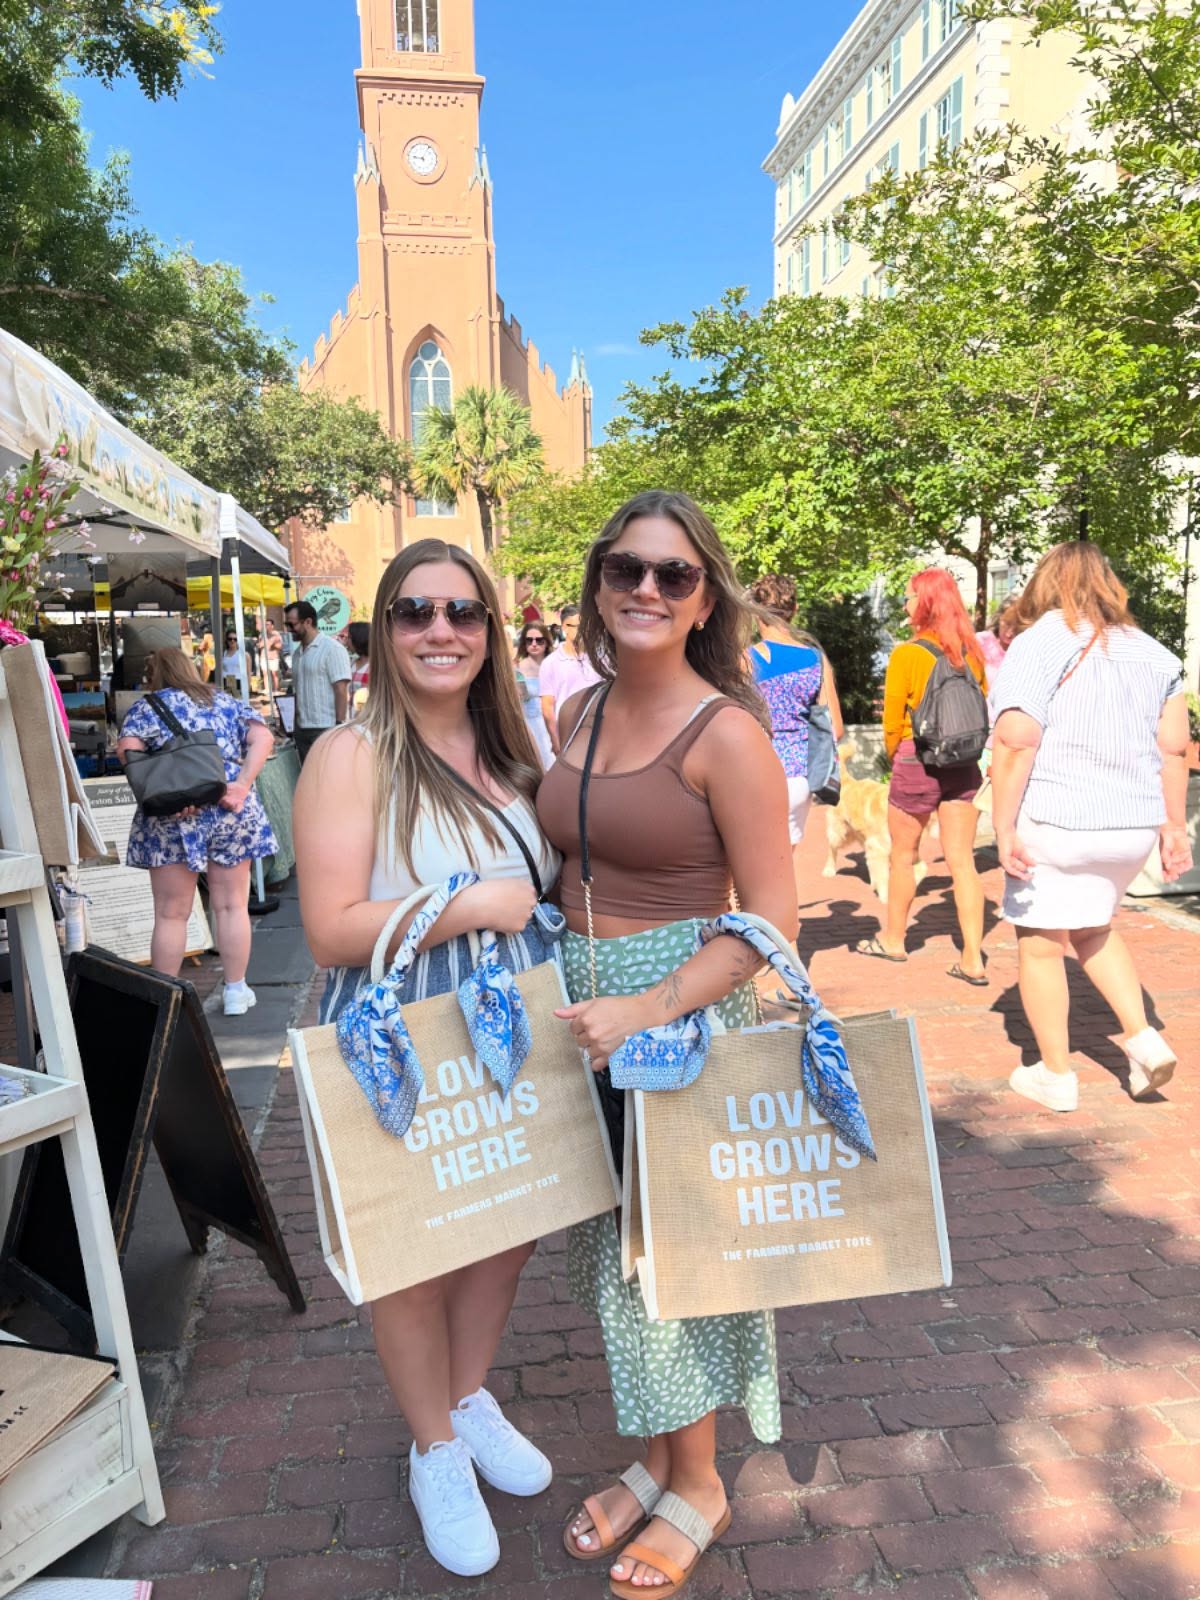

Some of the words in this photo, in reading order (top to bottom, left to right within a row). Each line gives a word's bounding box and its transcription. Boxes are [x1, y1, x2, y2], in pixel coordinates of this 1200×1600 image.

[417, 1054, 485, 1104] LOV
[403, 1080, 540, 1153] GROWS
[431, 1126, 532, 1192] HERE
[709, 1133, 861, 1180] GROWS
[424, 1215, 445, 1229] THE
[446, 1197, 493, 1221] FARMERS
[494, 1183, 533, 1205] MARKET
[535, 1172, 561, 1189] TOTE
[736, 1179, 845, 1226] HERE
[722, 1250, 743, 1262] THE
[746, 1243, 796, 1260] FARMERS
[798, 1238, 841, 1253] MARKET
[845, 1235, 873, 1248] TOTE
